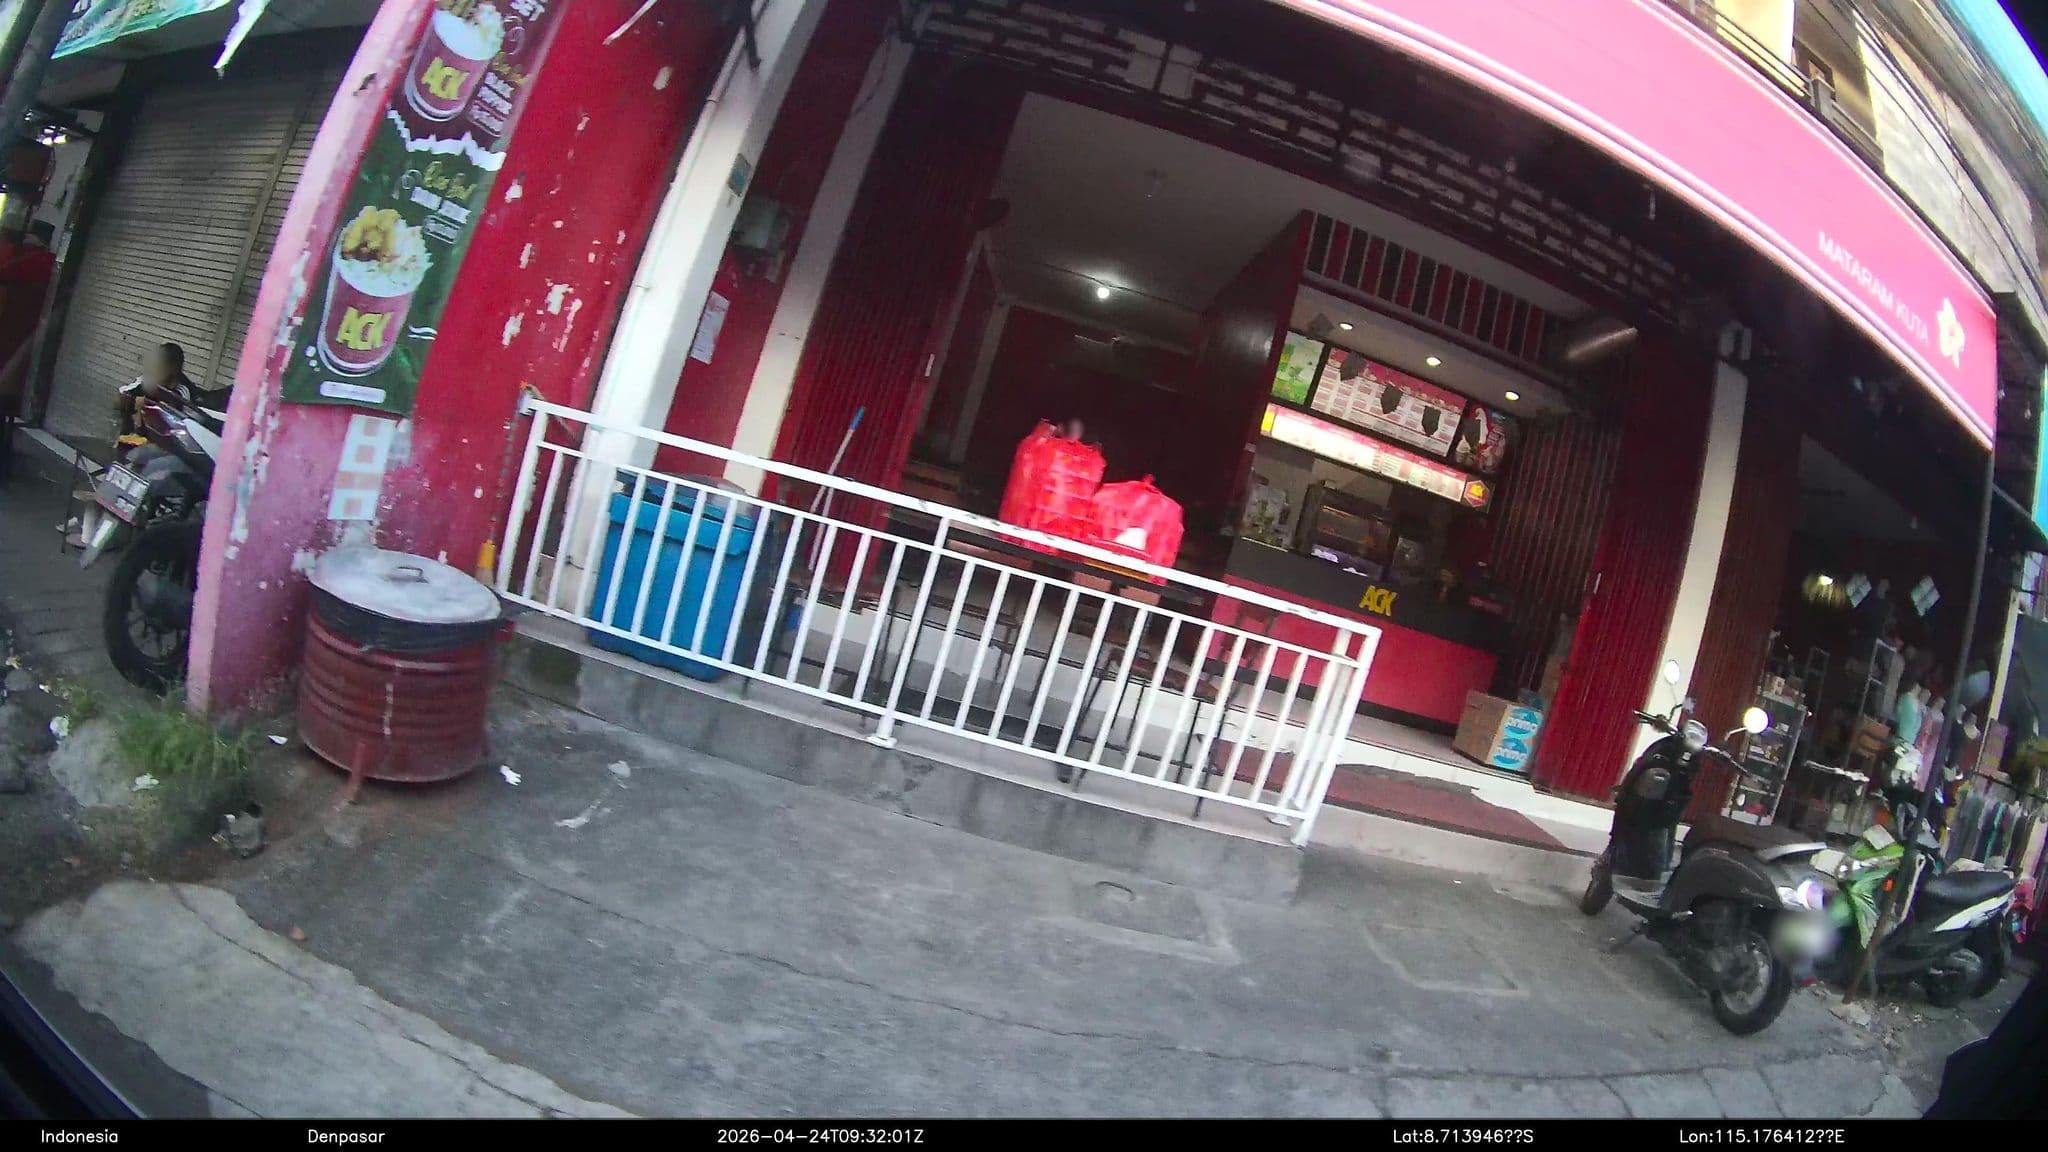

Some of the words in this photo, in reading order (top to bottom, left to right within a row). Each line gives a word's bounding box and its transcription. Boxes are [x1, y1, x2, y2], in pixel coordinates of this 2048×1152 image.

[421, 56, 472, 100] ACK
[1818, 230, 1895, 310] MATARAM
[1896, 302, 1930, 345] KUTA
[336, 306, 394, 350] ACK
[1358, 585, 1397, 617] ACK
